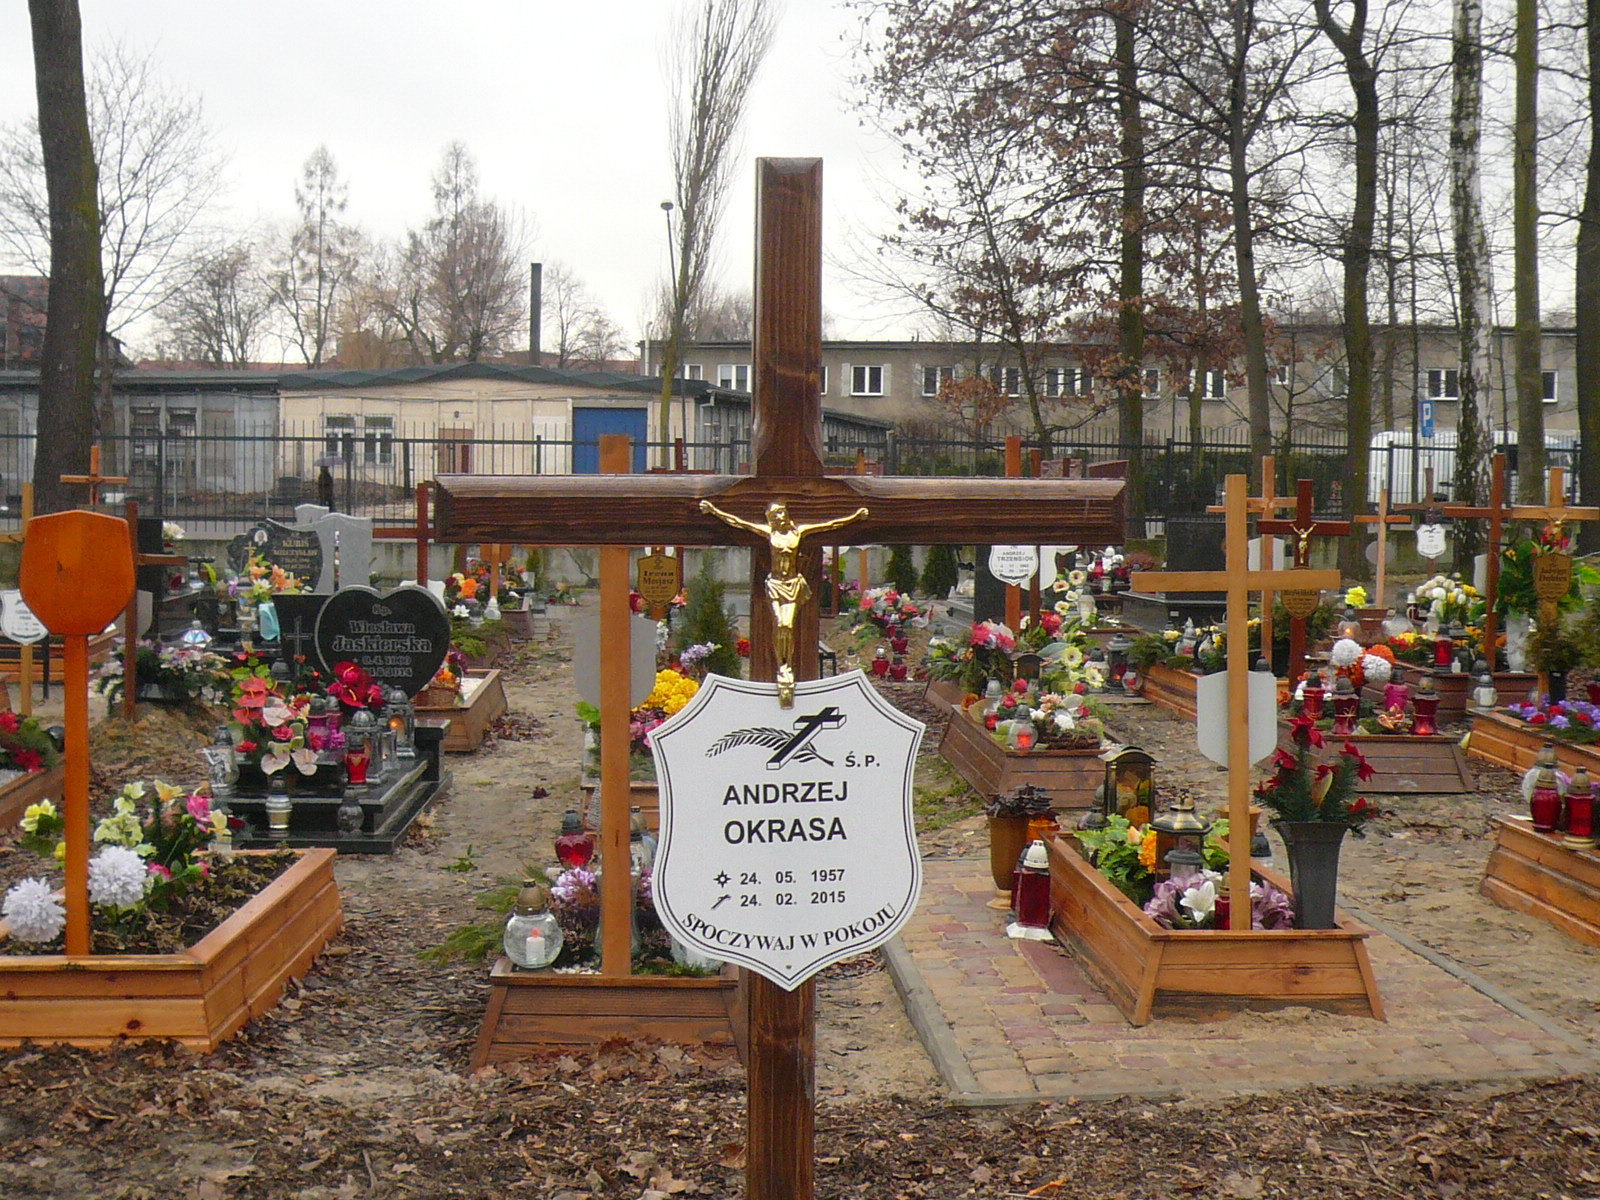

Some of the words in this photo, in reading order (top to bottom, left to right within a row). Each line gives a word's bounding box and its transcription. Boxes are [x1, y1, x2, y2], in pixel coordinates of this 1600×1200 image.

[1423, 403, 1431, 427] P
[332, 634, 432, 652] Jaskierska
[722, 781, 848, 806] ANDRZEJ
[724, 817, 847, 844] OKRASA
[740, 872, 761, 885] 24.
[775, 871, 796, 883] 05.
[811, 869, 845, 882] 1957
[740, 894, 762, 907] 24.
[775, 893, 797, 905] 02.
[811, 891, 846, 904] 2015
[682, 913, 795, 951] SPOCZYWAJ
[800, 933, 819, 949] W
[823, 903, 897, 946] POKOJU
